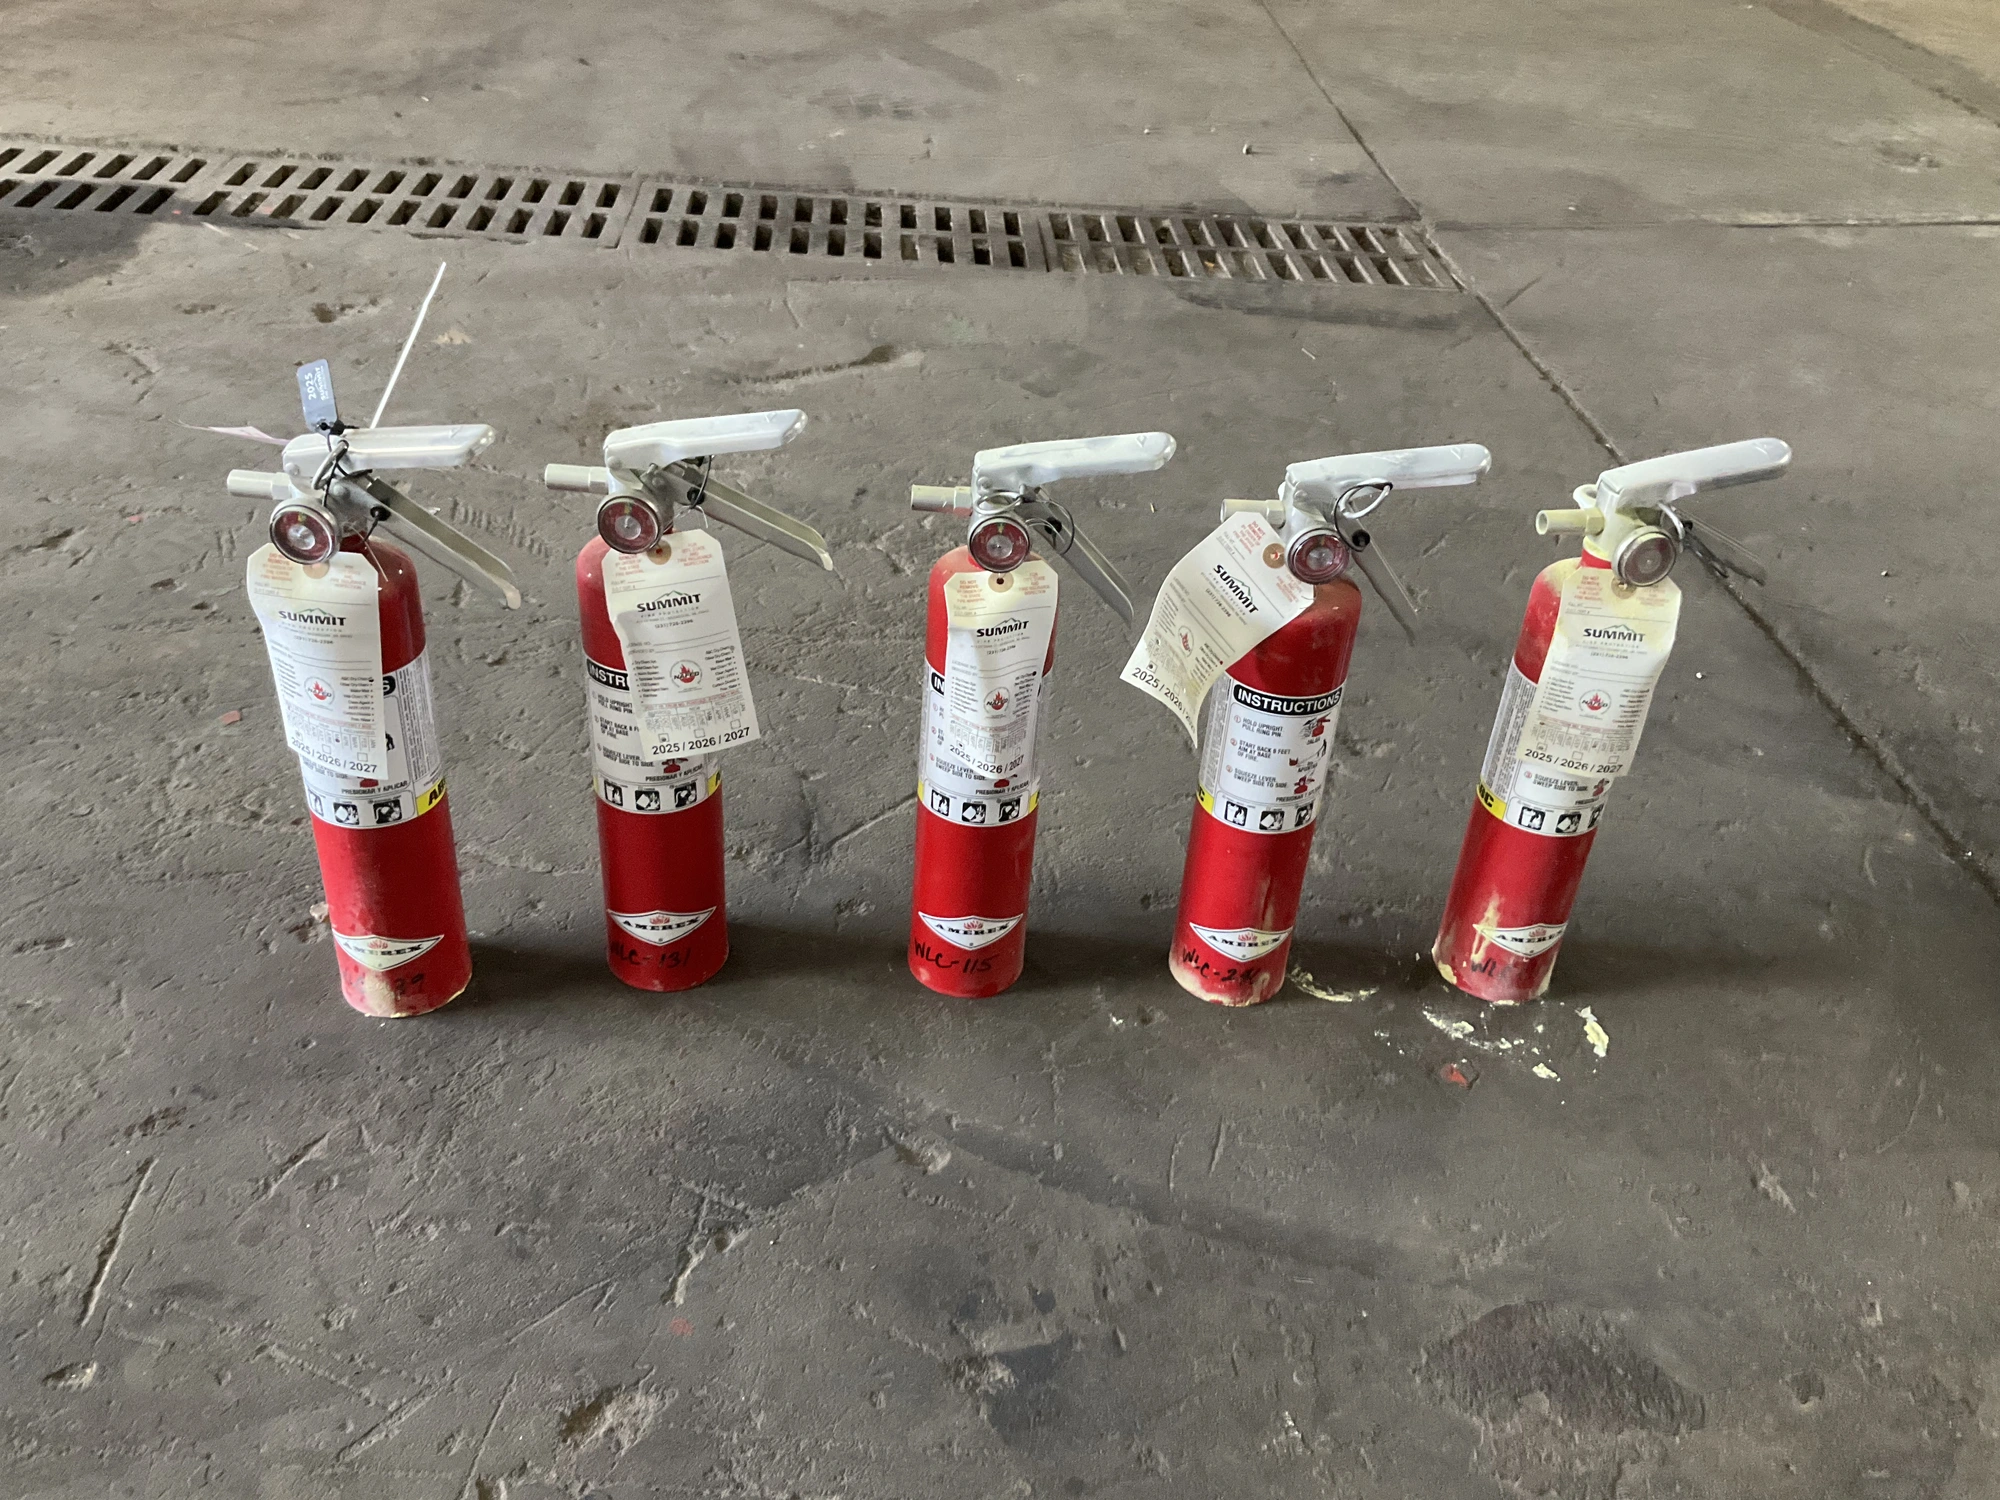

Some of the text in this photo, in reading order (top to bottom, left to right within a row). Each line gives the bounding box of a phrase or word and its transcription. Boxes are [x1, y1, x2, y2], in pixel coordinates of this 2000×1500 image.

[304, 372, 317, 401] 2025
[1210, 563, 1260, 615] SUMMIT
[637, 594, 701, 612] SUMMIT
[278, 610, 346, 626] SUMMIT
[976, 620, 1030, 638] SUMMIT
[1583, 628, 1645, 642] SUMMIT
[1132, 667, 1160, 689] 2025
[1238, 688, 1341, 712] INSTRUCTIONS
[1243, 717, 1257, 728] HOLD
[1258, 723, 1283, 732] UPRIGHT
[1256, 727, 1270, 736] RING
[651, 742, 680, 755] 2025
[688, 736, 717, 750] 2026
[723, 727, 751, 743] 2027
[1239, 740, 1256, 750] START
[1257, 745, 1272, 753] BACK
[949, 745, 971, 763] 2025
[977, 761, 1003, 774] 2026
[1009, 755, 1024, 771] 2027
[1238, 746, 1249, 754] AIM
[1257, 751, 1271, 759] BASE
[1525, 749, 1552, 763] 2025
[1560, 758, 1588, 772] 2026
[1596, 764, 1623, 773] 2027
[317, 751, 341, 768] 2026
[349, 761, 378, 773] 2027
[1234, 773, 1251, 785] SWEEP
[1253, 778, 1265, 787] SIDE
[1235, 768, 1257, 778] SQUEEZE
[623, 916, 700, 931] AMEREX
[935, 922, 1010, 935] AMEREX
[1208, 935, 1280, 947] AMEREX
[915, 937, 999, 974] WLC-115
